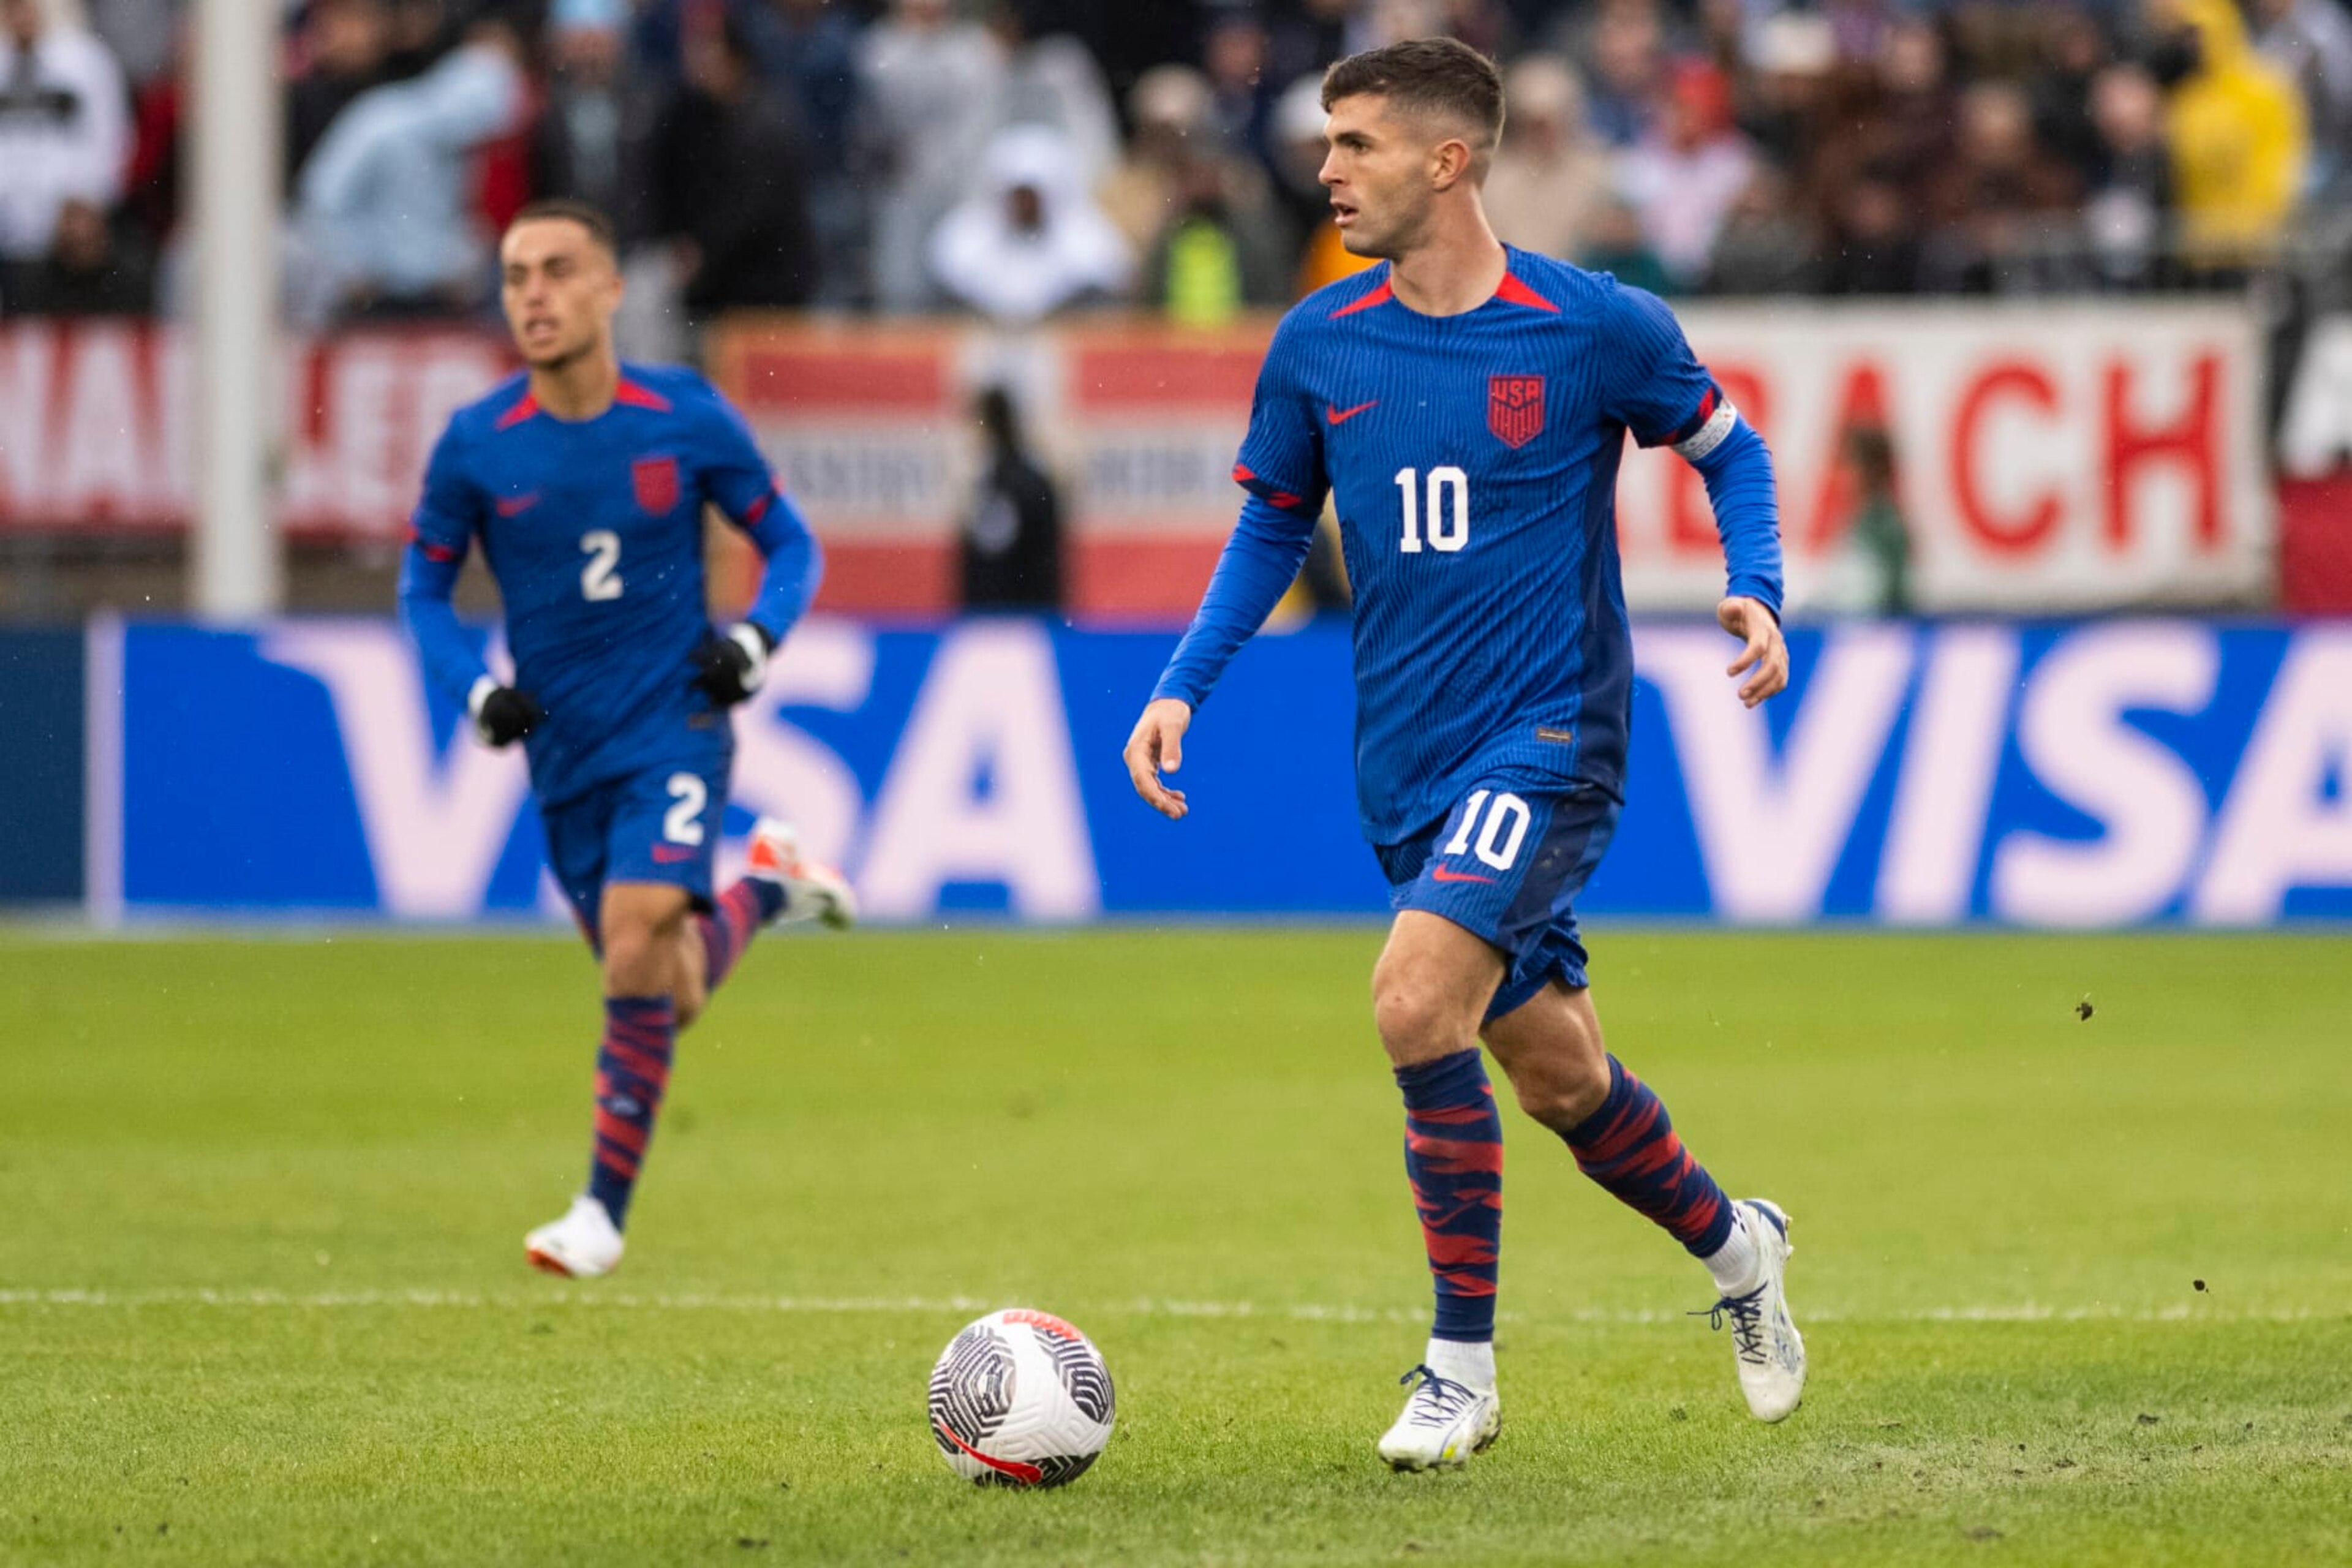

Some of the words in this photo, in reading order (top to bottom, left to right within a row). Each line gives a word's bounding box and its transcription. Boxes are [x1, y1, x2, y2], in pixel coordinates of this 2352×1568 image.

[1494, 380, 1539, 407] USA
[1395, 466, 1468, 552] 10
[580, 529, 624, 601] 2
[260, 620, 1102, 919] VSA
[663, 772, 707, 846] 2
[1630, 625, 2352, 924] VISA
[1444, 789, 1531, 871] 10
